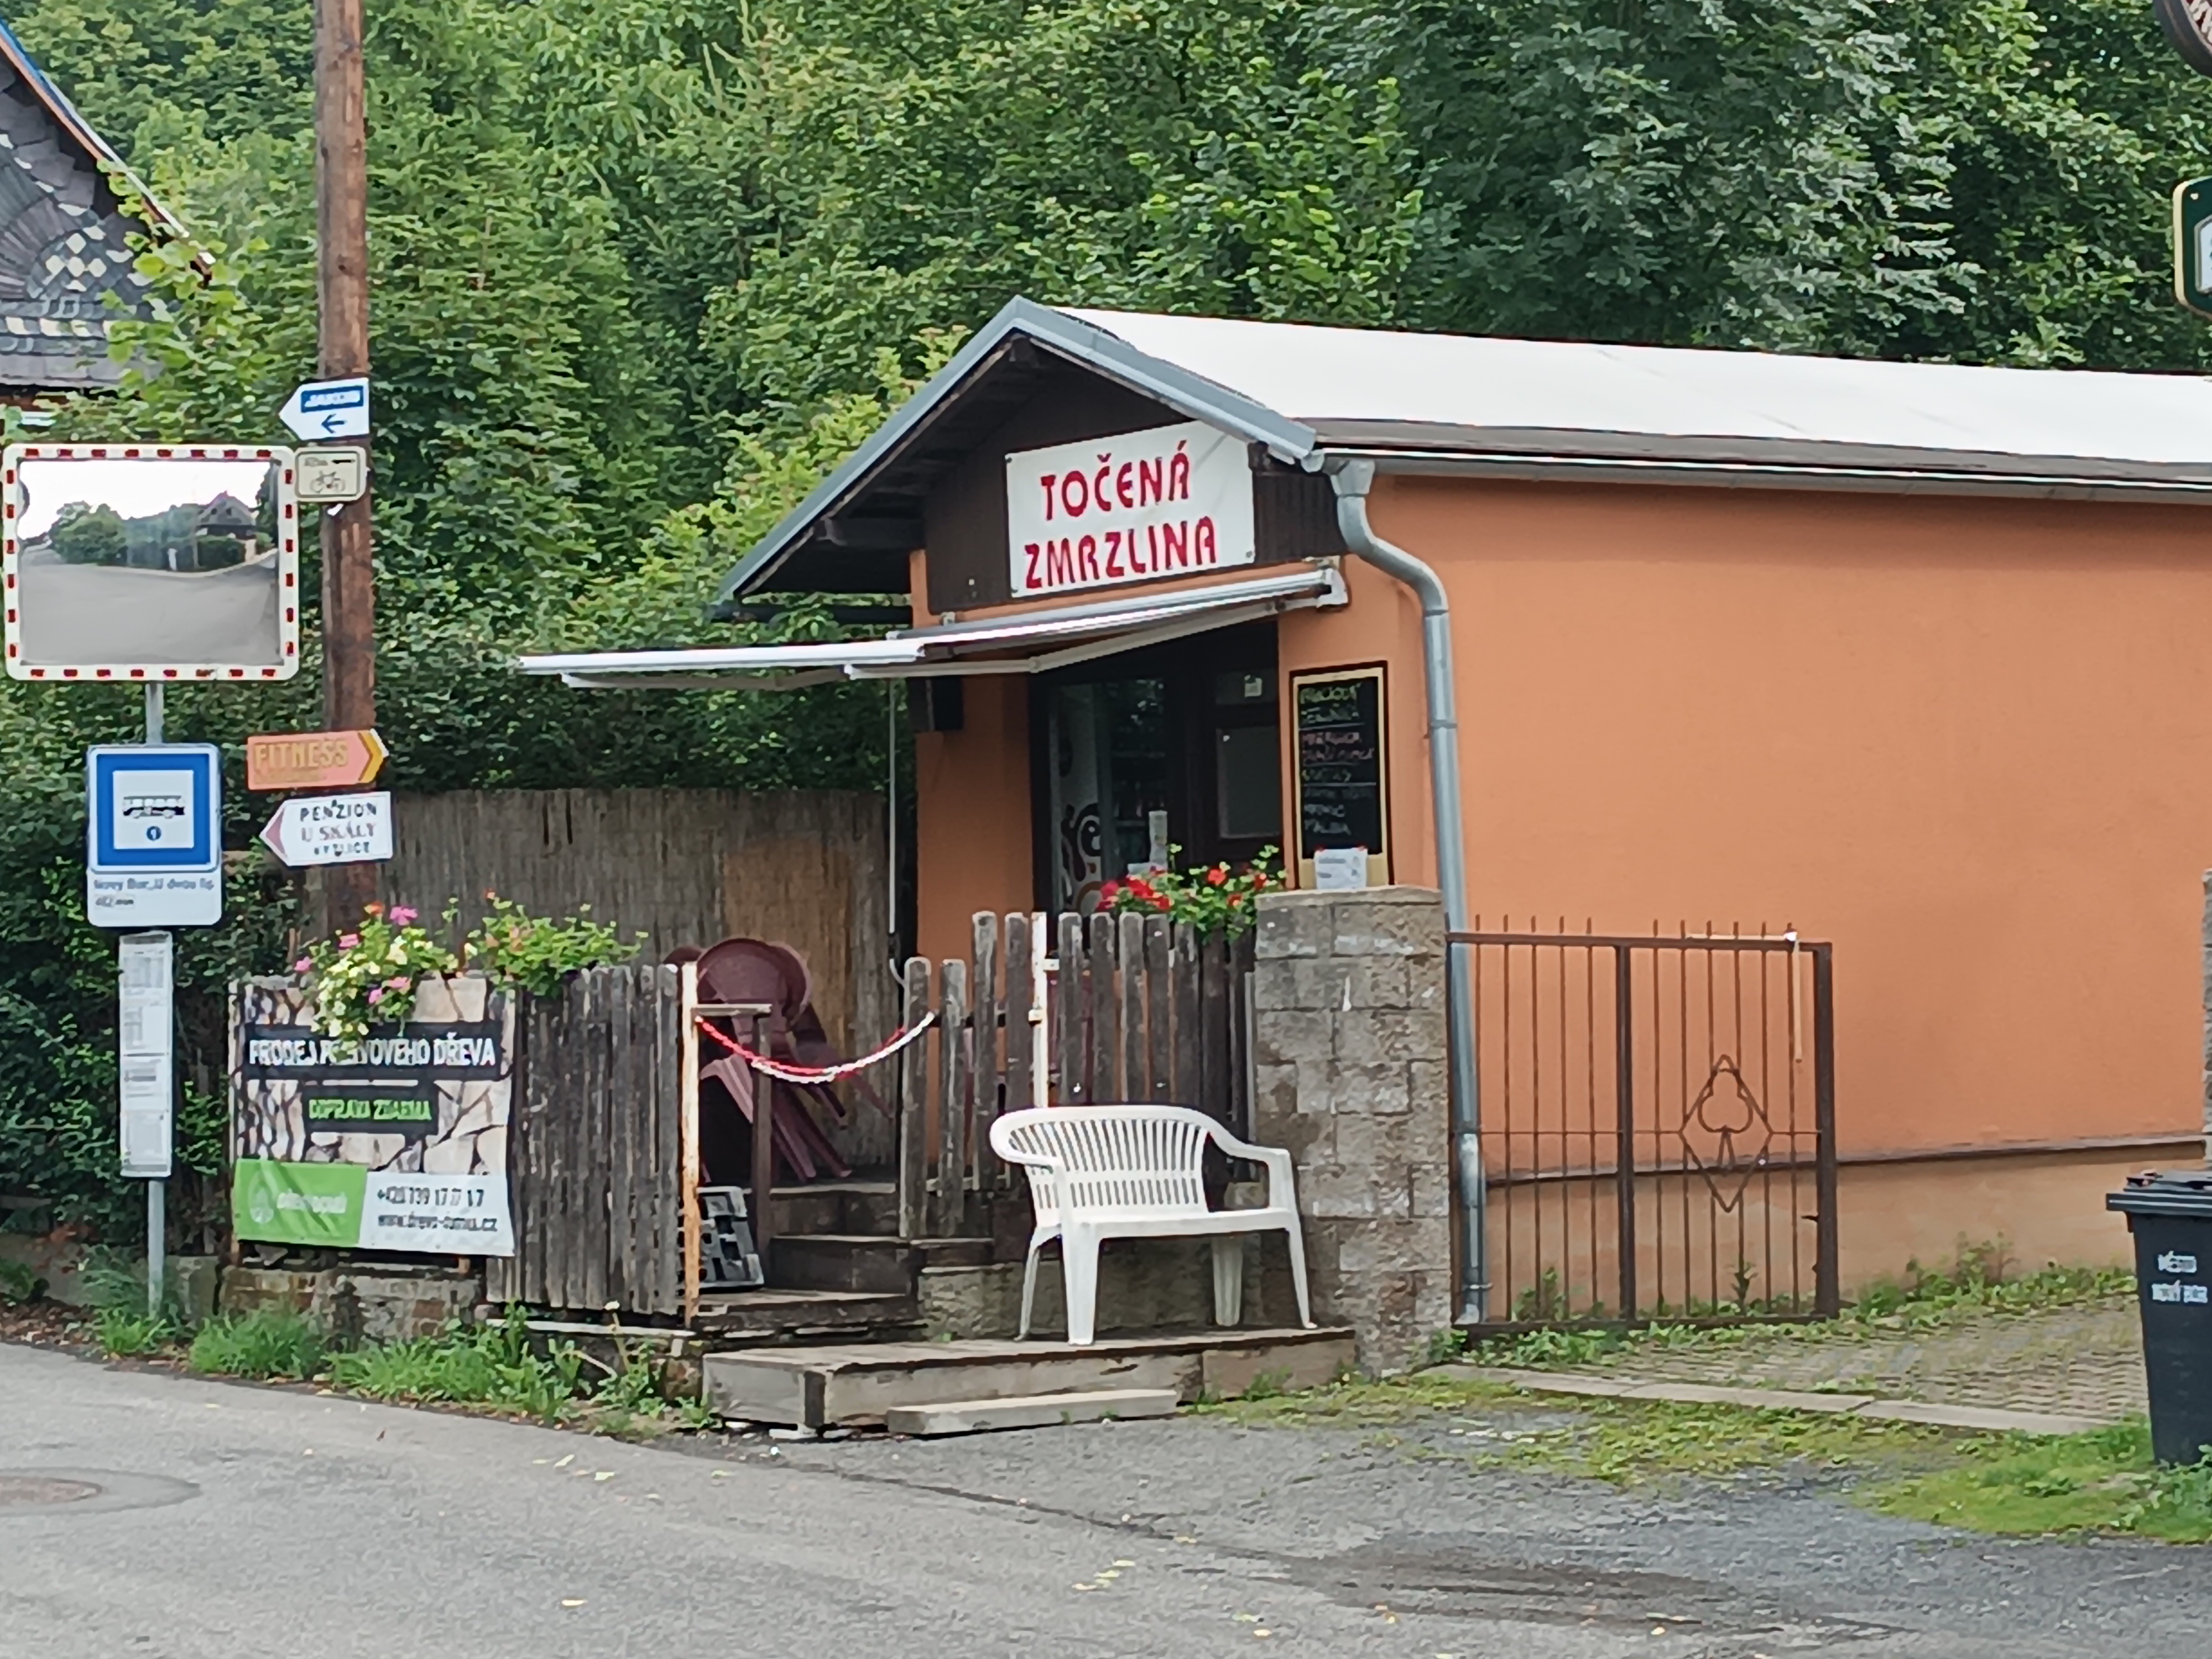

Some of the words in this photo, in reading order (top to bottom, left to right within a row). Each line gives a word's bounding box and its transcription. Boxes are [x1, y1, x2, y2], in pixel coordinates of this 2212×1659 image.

[1040, 440, 1190, 521] TOČENÁ
[1024, 516, 1217, 589] ZMRZLINA
[254, 740, 348, 770] FITNESS
[300, 802, 377, 822] PENZION
[301, 827, 314, 842] U
[249, 1039, 318, 1066] PRODEJ
[433, 1031, 496, 1066] DŘEVA
